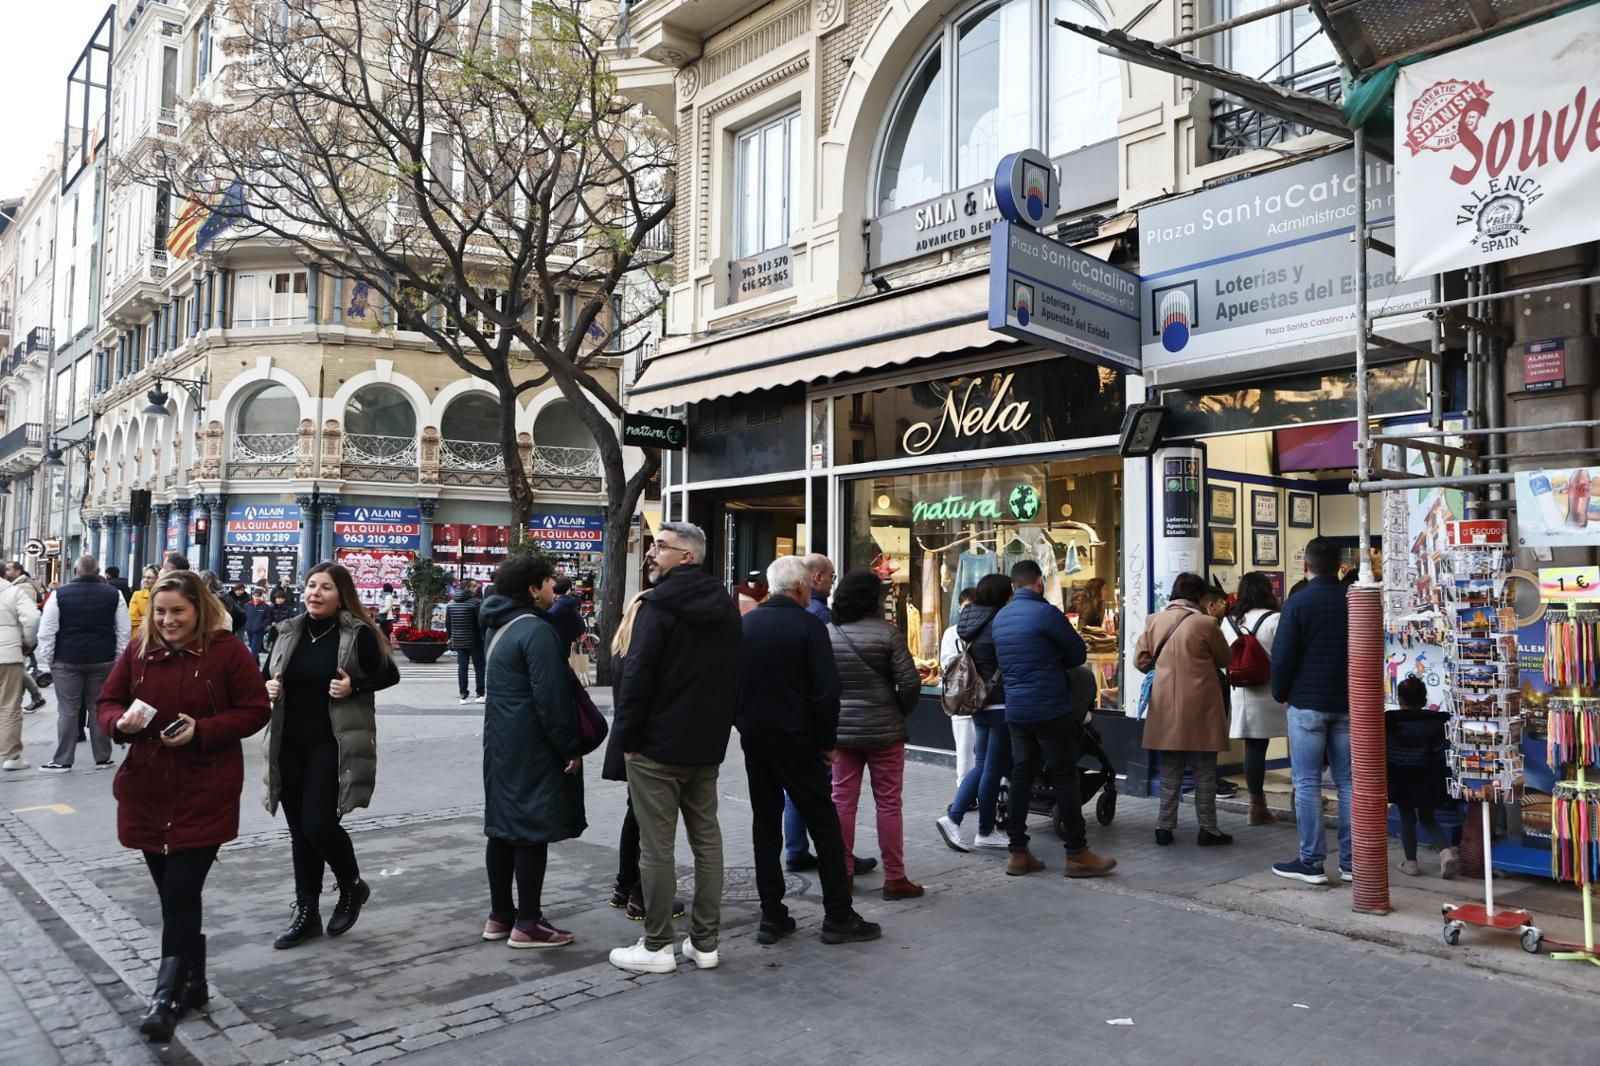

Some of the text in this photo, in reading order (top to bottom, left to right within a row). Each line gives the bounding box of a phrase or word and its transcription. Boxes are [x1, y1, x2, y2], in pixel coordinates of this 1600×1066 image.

[1413, 86, 1457, 120] AUTHENTIC
[1412, 87, 1477, 142] SPANISH
[1456, 175, 1544, 226] VALENCIA
[915, 198, 956, 231] SALA
[964, 191, 977, 216] &
[916, 228, 966, 251] ADVANCED
[1147, 222, 1195, 245] Plaza
[1481, 235, 1519, 253] SPAIN
[742, 255, 788, 279] 963 913 570
[1011, 235, 1135, 296] Plaza SantaCatalina
[742, 280, 756, 292] 616
[758, 274, 771, 288] 525
[1215, 264, 1303, 296] Loterías y
[1215, 288, 1303, 322] Apuestas
[1304, 279, 1333, 302] del
[1041, 306, 1073, 327] Apuestas
[1087, 322, 1110, 340] Estado
[1286, 322, 1308, 331] Santa
[1310, 315, 1343, 327] Catalina
[1528, 352, 1560, 362] ALARMA
[902, 372, 1032, 456] Nela
[626, 425, 667, 439] natura
[258, 507, 285, 516] ALAIN
[370, 509, 402, 518] ALAIN
[912, 494, 1004, 523] natura
[234, 521, 293, 530] ALQUILADO
[343, 525, 412, 533] ALQUILADO
[557, 517, 586, 525] ALAIN
[235, 533, 290, 542] 963 210 289
[343, 534, 409, 544] 963 210 289
[532, 530, 596, 539] ALQUILADO
[555, 541, 572, 549] 210
[574, 542, 592, 550] 289
[1557, 574, 1590, 592] 1 €
